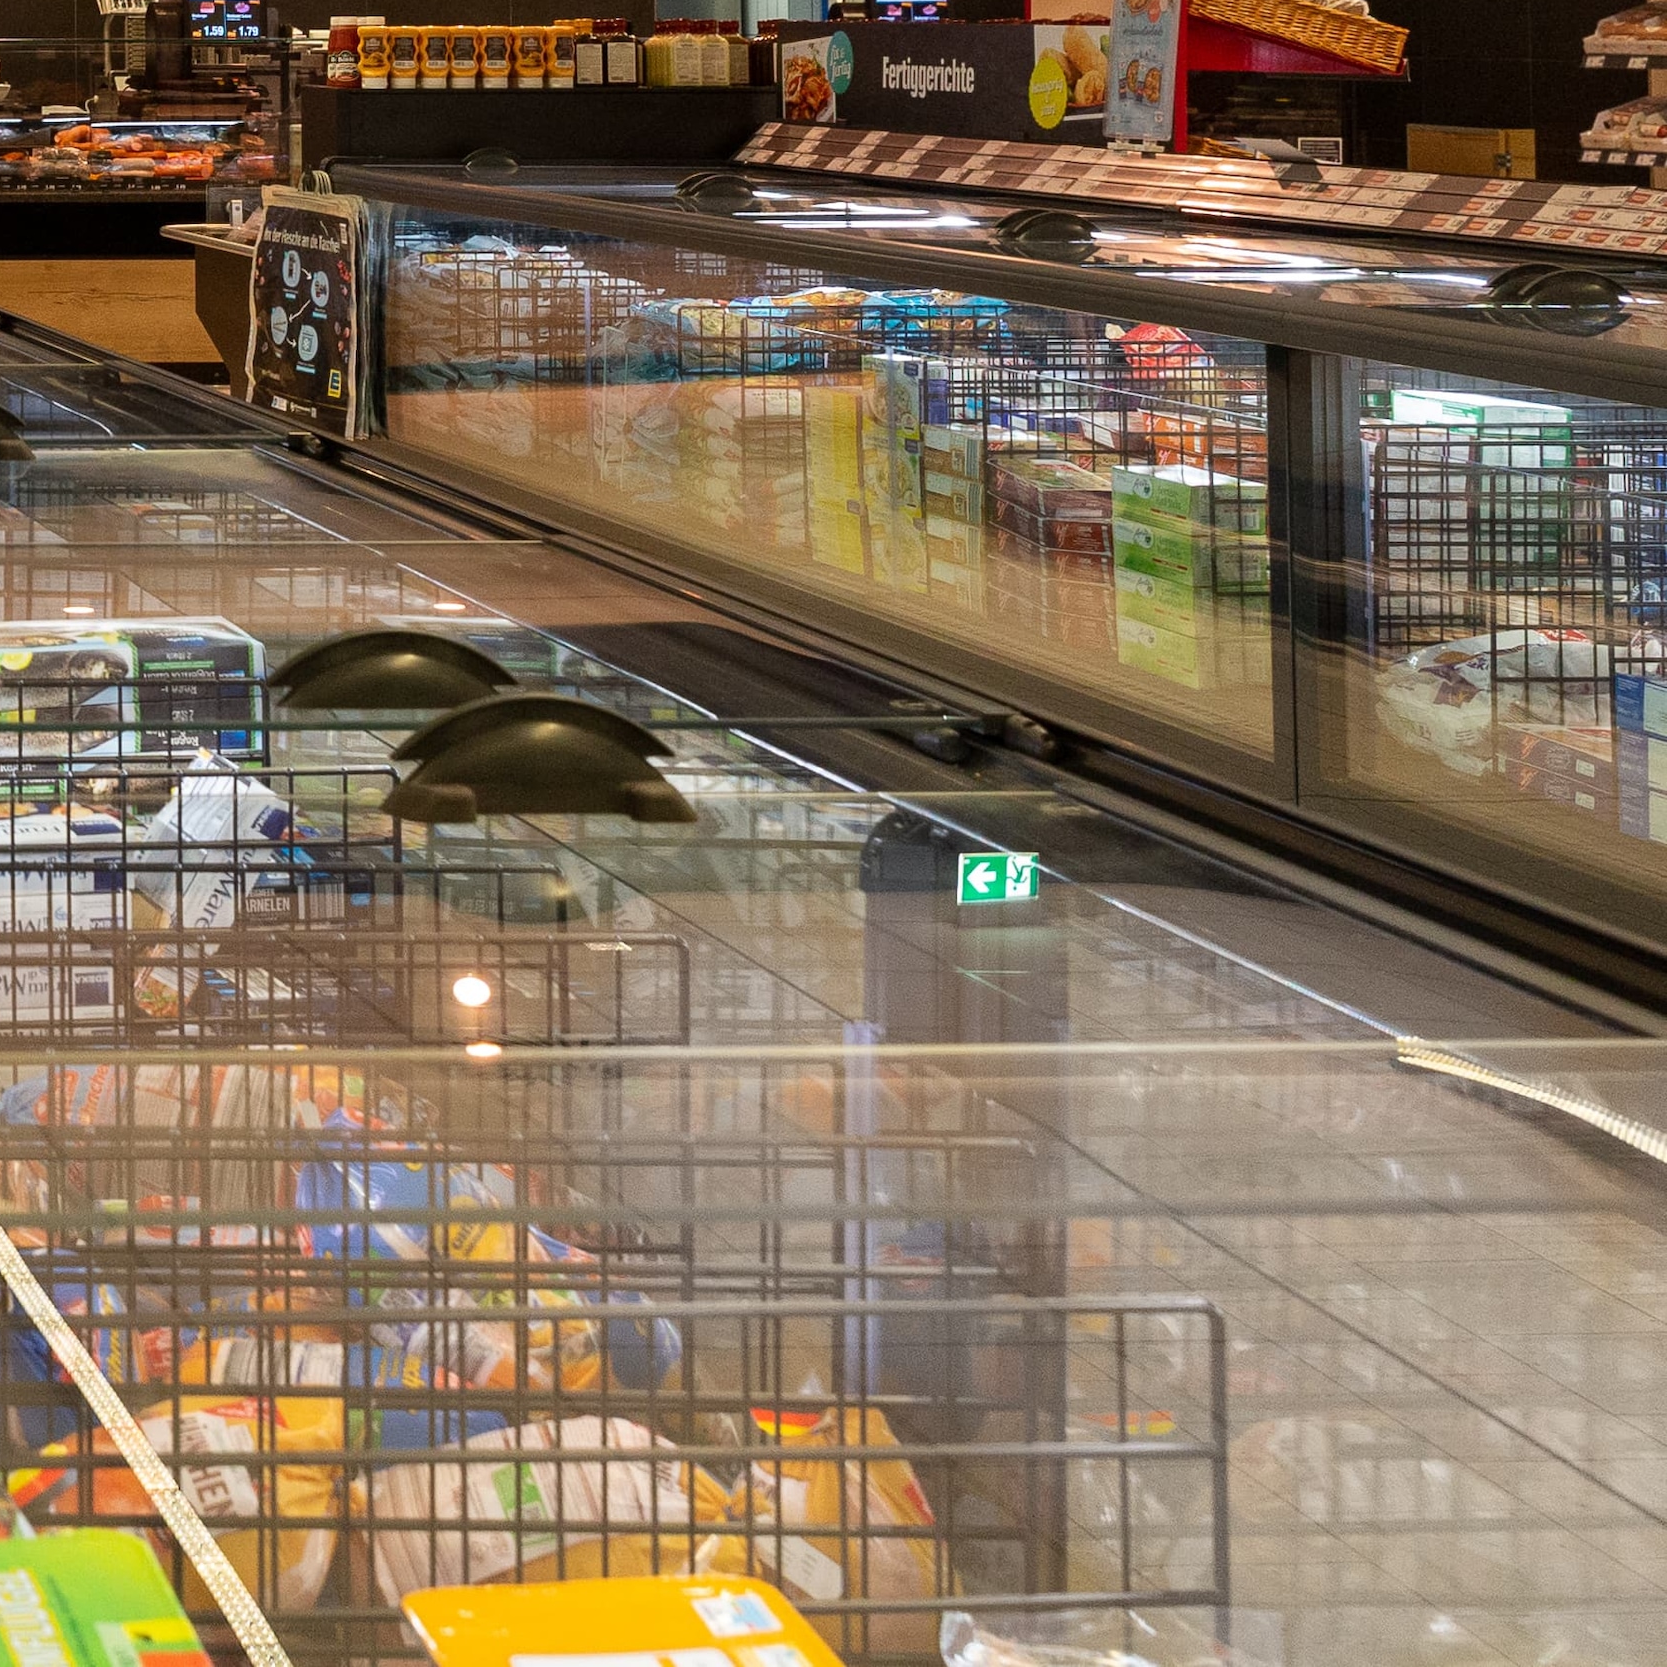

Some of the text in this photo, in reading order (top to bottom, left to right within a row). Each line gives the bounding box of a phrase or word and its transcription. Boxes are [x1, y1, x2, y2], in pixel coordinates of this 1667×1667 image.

[203, 25, 225, 37] 1.59
[238, 25, 259, 37] 1.79
[882, 56, 975, 98] Fertiggerichte
[245, 896, 291, 914] ARNELEN
